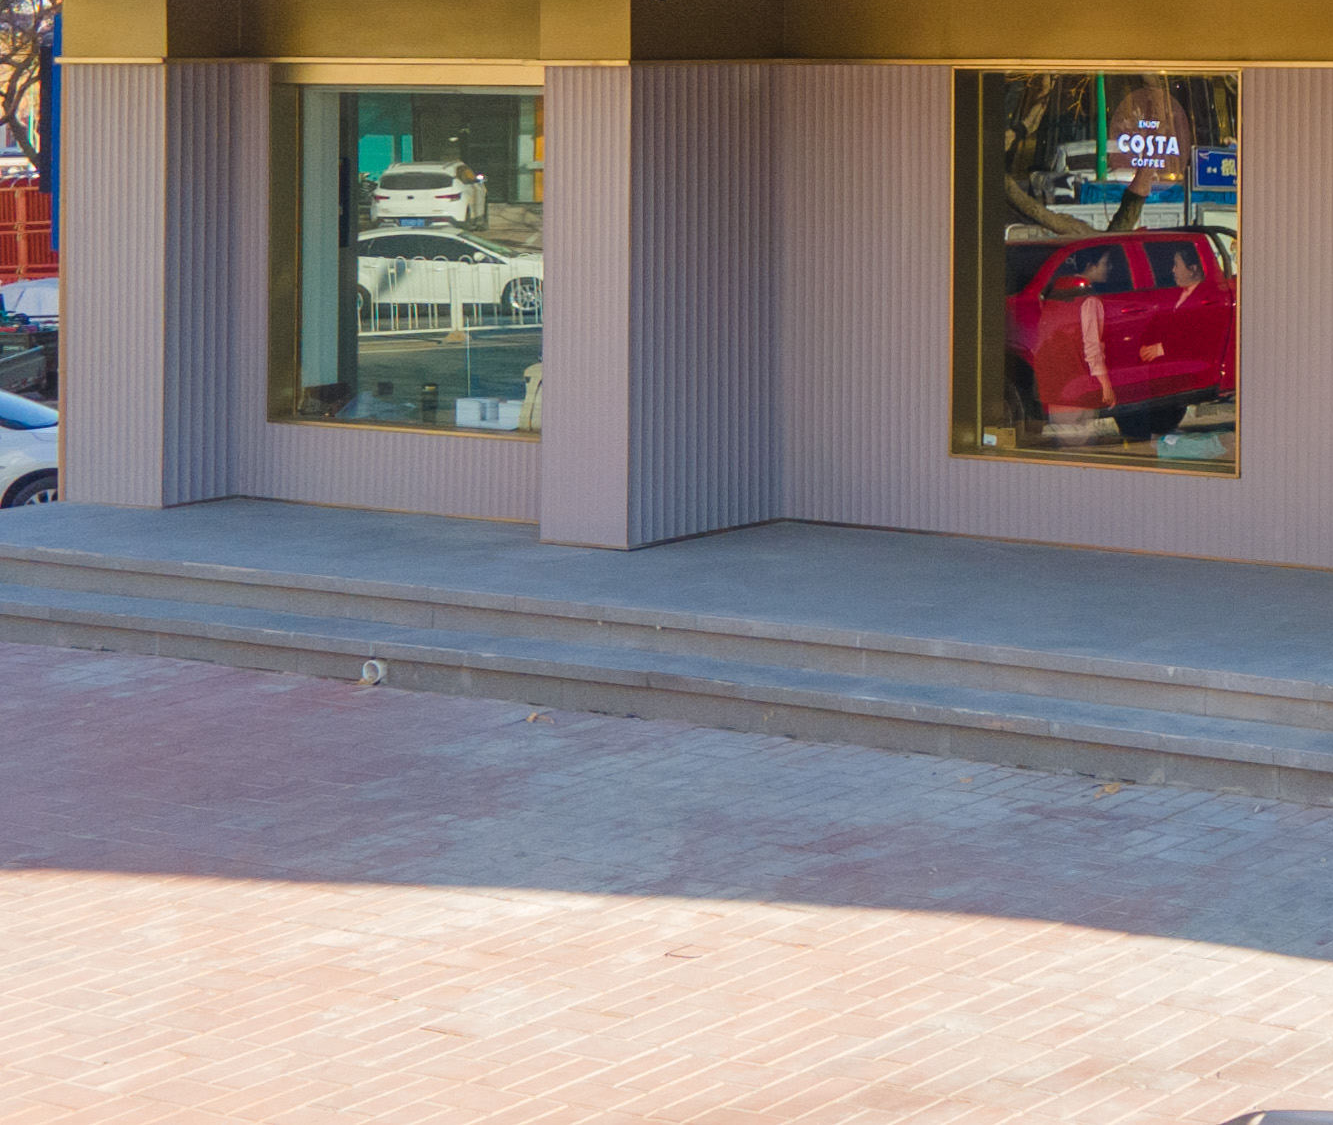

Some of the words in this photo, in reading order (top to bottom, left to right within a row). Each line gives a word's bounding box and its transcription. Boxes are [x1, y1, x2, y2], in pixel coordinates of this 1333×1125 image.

[1138, 120, 1160, 130] ENJOY
[1118, 134, 1180, 156] COSTA
[1131, 157, 1166, 169] COFFEE
